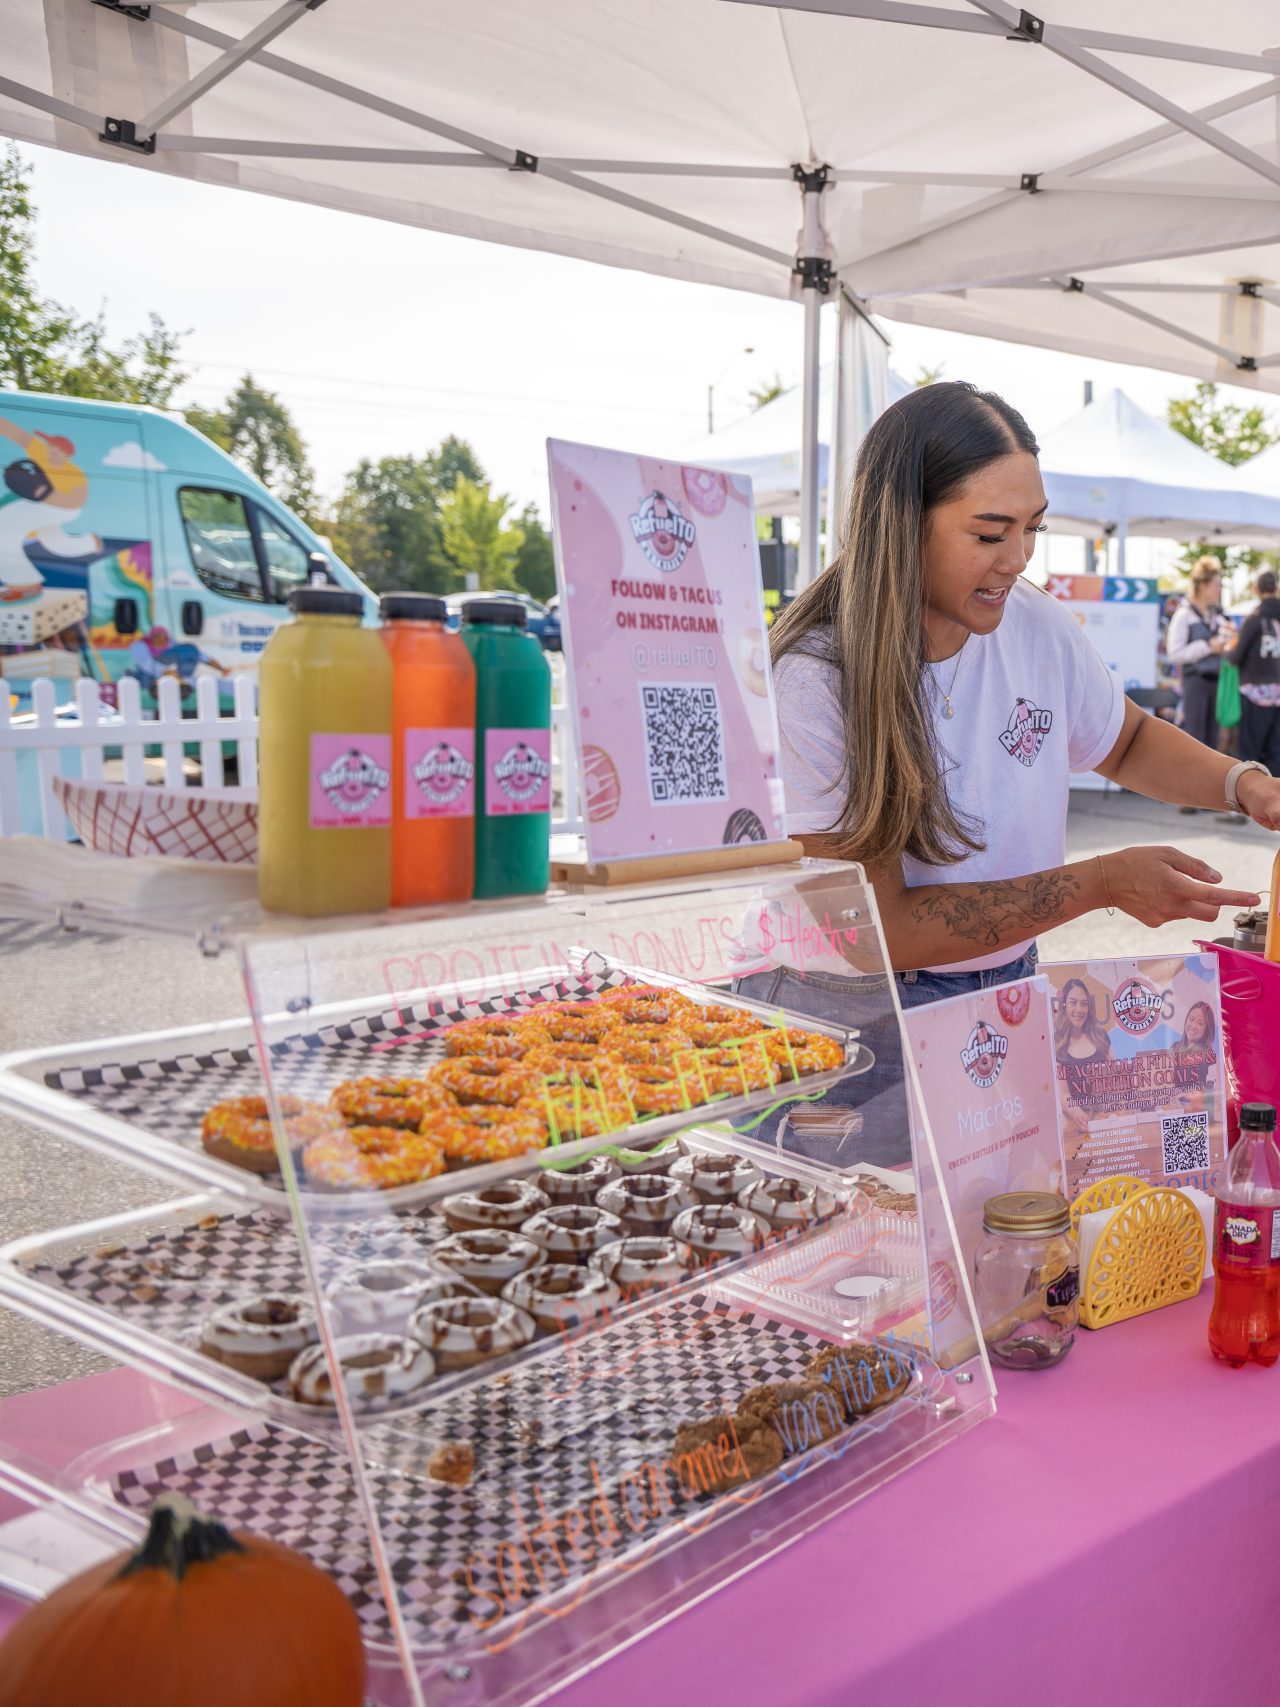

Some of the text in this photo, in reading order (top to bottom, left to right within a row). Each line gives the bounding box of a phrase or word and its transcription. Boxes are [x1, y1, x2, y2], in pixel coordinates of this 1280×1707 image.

[628, 508, 697, 544] RefuelTO
[611, 578, 723, 606] FOLLOW & TAG US
[616, 610, 637, 629] ON
[999, 709, 1052, 756] RefuelTO
[382, 940, 594, 1026] PROTEIN
[608, 916, 747, 988] DONUTS
[1112, 993, 1163, 1016] RefuelTO
[960, 1035, 1009, 1072] RefuelTO
[1103, 1056, 1145, 1076] YOUR
[1147, 1050, 1203, 1070] FITNESS
[1205, 1048, 1217, 1065] &
[1072, 1066, 1199, 1095] NUTRITION GOALS
[957, 1096, 1023, 1138] Macros
[949, 1155, 971, 1170] ENERGY
[972, 1143, 994, 1160] BOTTLES
[999, 1134, 1016, 1149] SIPPY
[1016, 1125, 1040, 1142] POUCHES
[1118, 1162, 1140, 1170] SUPPORT
[1226, 1223, 1258, 1233] CANADA
[1232, 1230, 1248, 1239] DRY
[772, 1353, 878, 1452] vanilla
[465, 1400, 752, 1630] salted caramel
